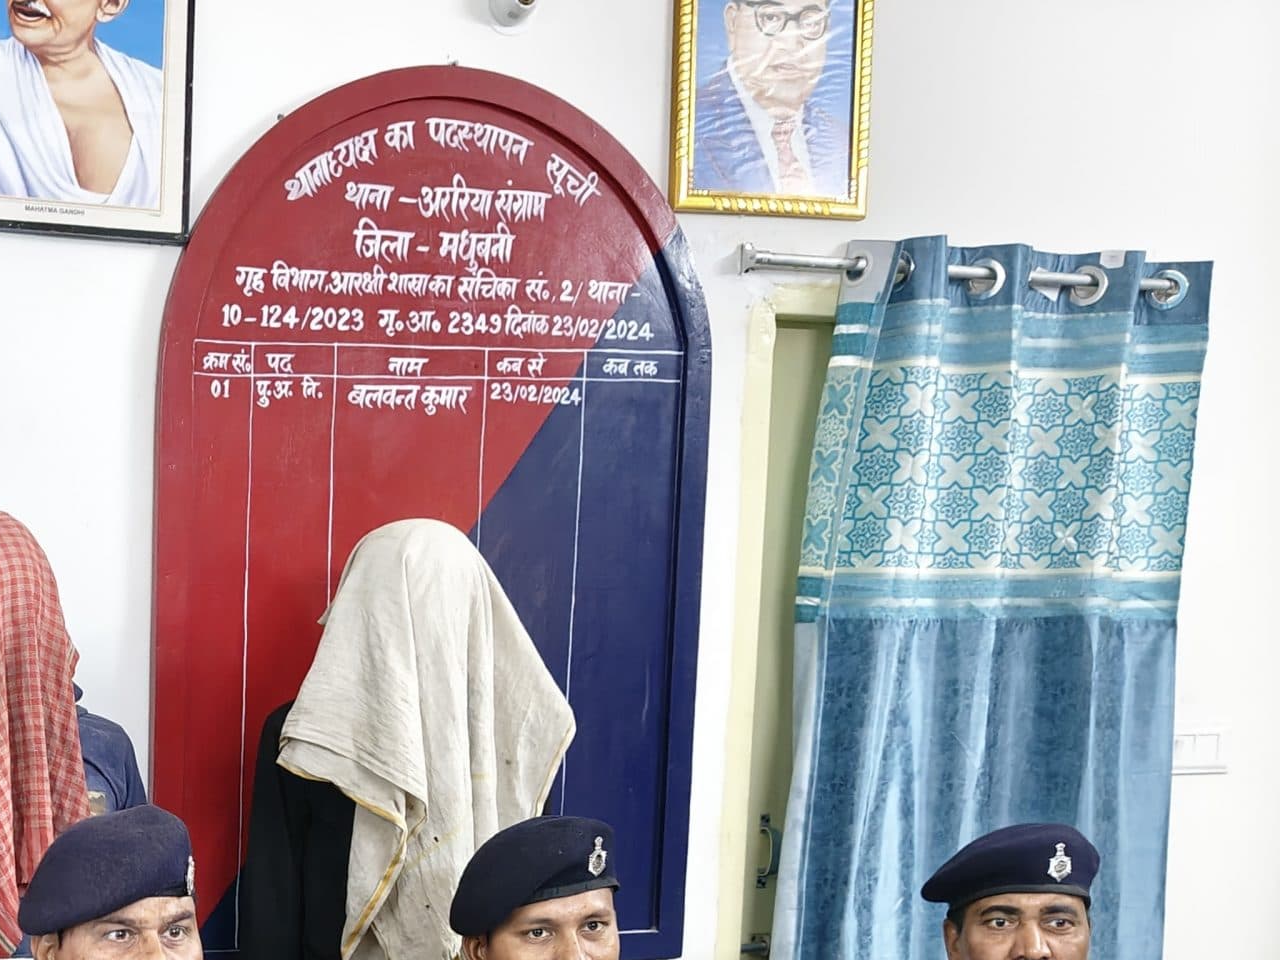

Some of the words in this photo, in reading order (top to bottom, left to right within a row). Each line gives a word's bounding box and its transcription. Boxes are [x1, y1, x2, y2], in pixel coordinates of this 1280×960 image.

[384, 120, 417, 152] का
[425, 117, 535, 165] पदस्थापन
[545, 152, 603, 206] सूची
[24, 205, 58, 214] MAHATMA
[59, 207, 86, 216] GANDHI
[344, 181, 395, 211] थाना
[495, 179, 552, 222] संग्राम
[352, 216, 416, 263] जिला
[438, 221, 516, 272] मधुबनी
[235, 265, 269, 297] गृह
[447, 310, 502, 335] 2349
[503, 303, 550, 339] दिनांक
[550, 315, 655, 343] 23/02/2024
[202, 350, 232, 371] क्रम
[265, 352, 296, 374] पद
[387, 356, 429, 376] नाम
[496, 356, 526, 375] कब
[526, 352, 548, 377] से
[602, 357, 631, 377] कब
[633, 360, 659, 376] तक
[210, 379, 230, 399] 01
[347, 383, 421, 410] बलवन्त
[421, 384, 472, 415] कुमार
[490, 382, 583, 407] 23/02/2024
